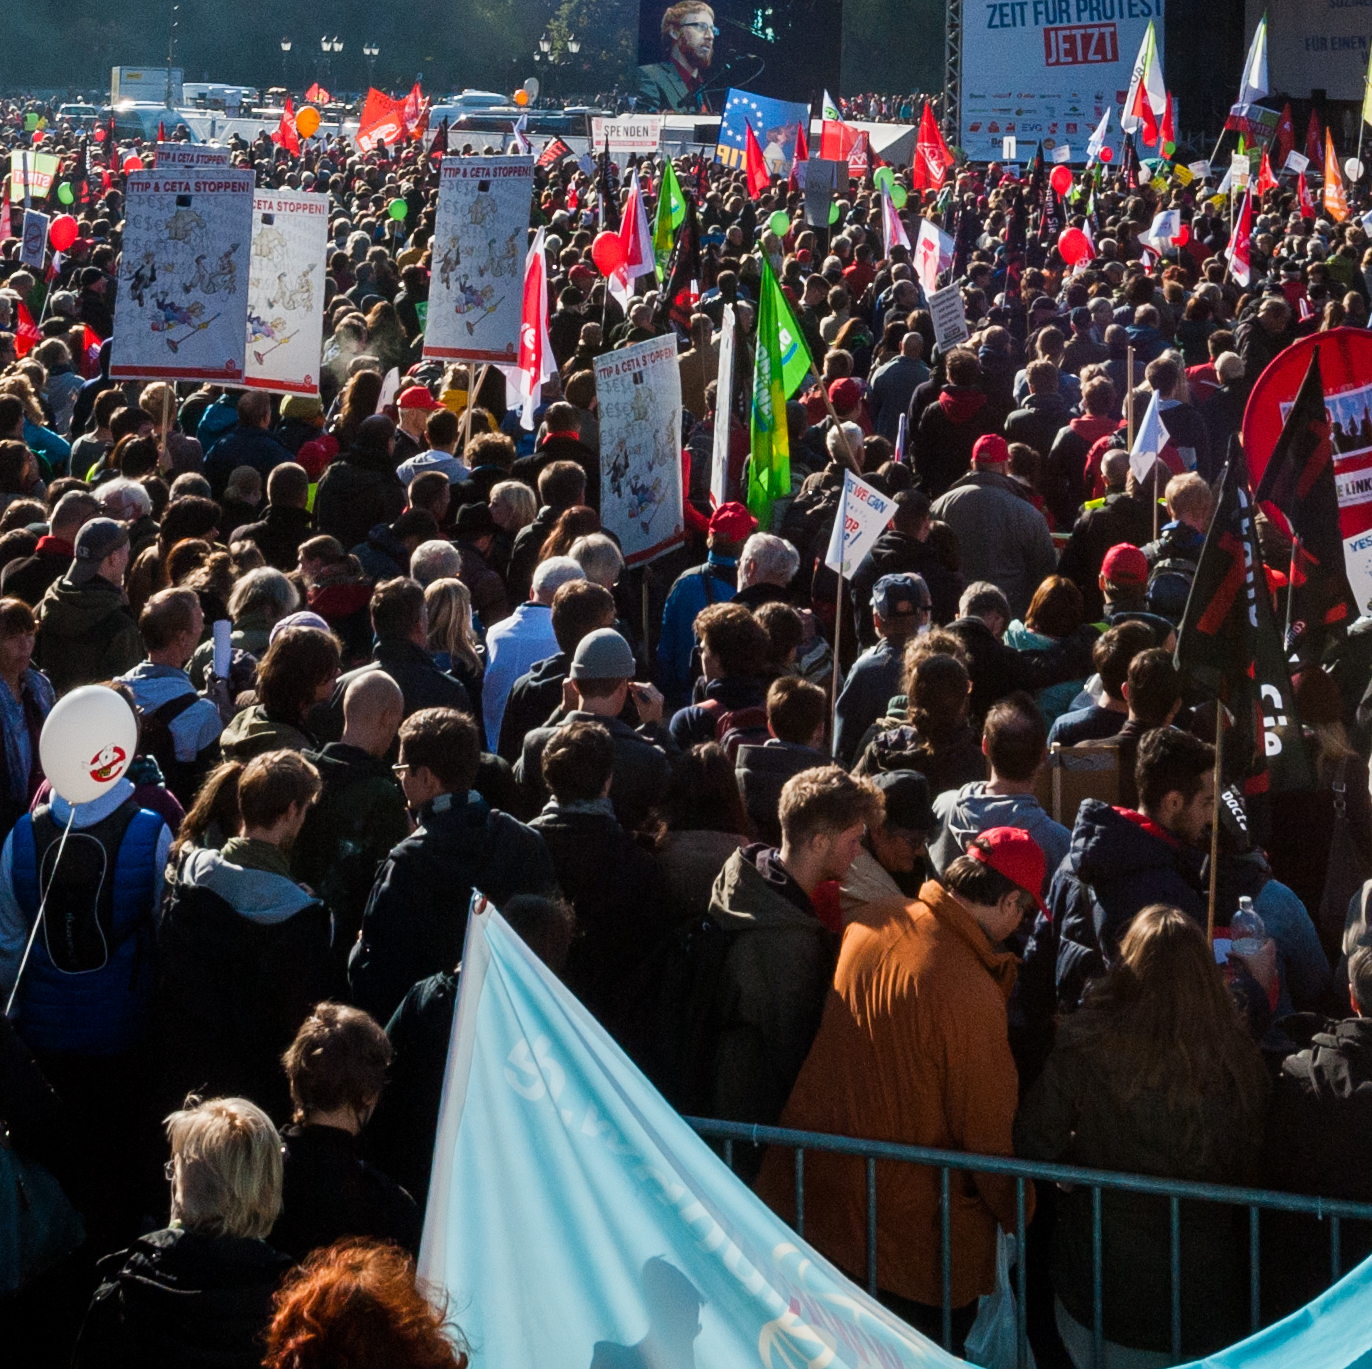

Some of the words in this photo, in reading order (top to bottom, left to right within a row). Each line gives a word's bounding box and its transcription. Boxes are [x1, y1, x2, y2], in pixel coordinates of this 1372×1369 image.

[986, 1, 1028, 29] ZEIT
[1047, 26, 1116, 64] JETZT
[1304, 34, 1328, 51] FÜR
[1331, 34, 1366, 50] EINEN
[604, 125, 649, 137] SPENDEN
[178, 152, 195, 163] CETA
[443, 167, 461, 178] TTIP
[470, 167, 491, 178] CETA
[492, 165, 532, 178] STOPPEN!
[130, 181, 151, 193] TTIP
[153, 181, 160, 192] &
[164, 181, 191, 192] CETA
[194, 180, 250, 193] STOPPEN!
[276, 201, 325, 215] STOPPEN!
[598, 365, 614, 381] TTIP
[621, 357, 641, 373] CETA
[853, 484, 869, 502] WE
[867, 494, 888, 514] CAN
